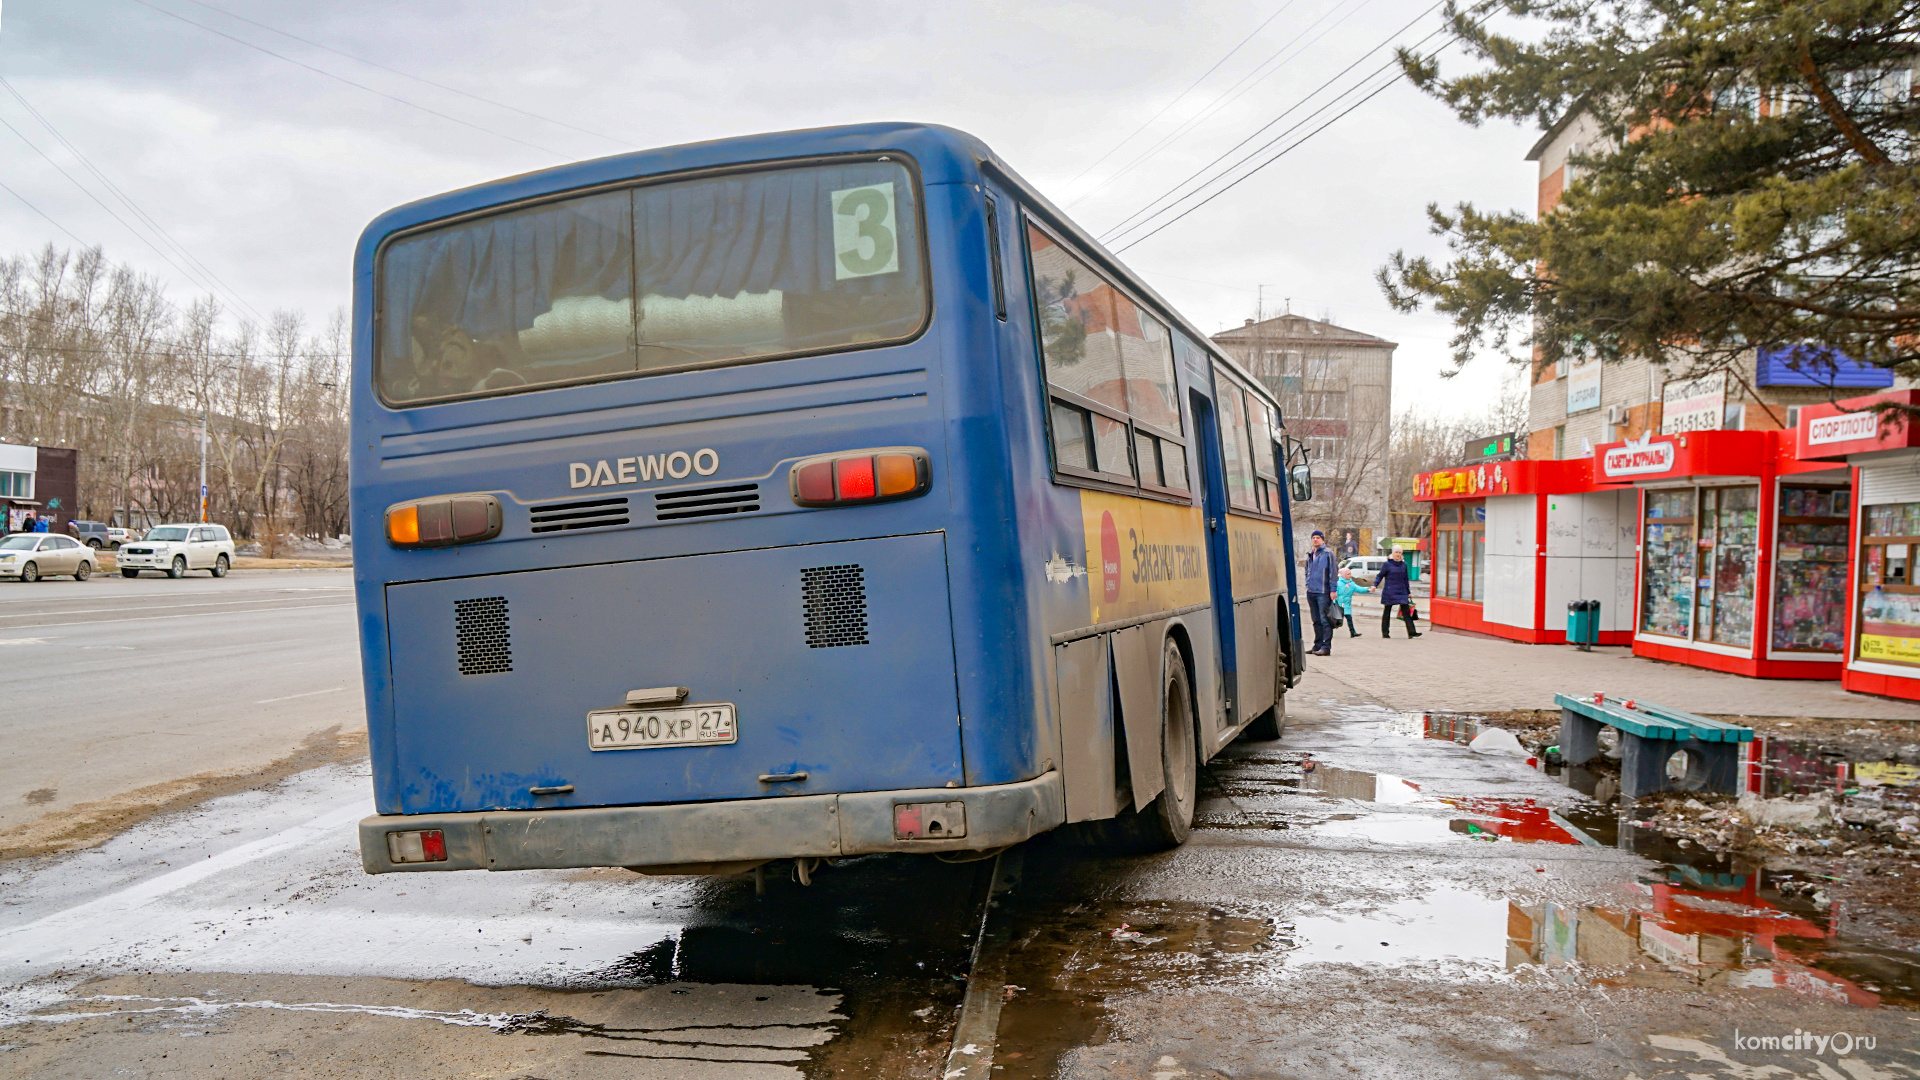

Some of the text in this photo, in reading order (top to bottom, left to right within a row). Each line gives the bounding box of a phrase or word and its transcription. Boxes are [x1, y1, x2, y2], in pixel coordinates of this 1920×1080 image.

[837, 188, 894, 274] 3
[1674, 410, 1716, 433] 51-51-33
[1812, 416, 1874, 439] СПОРТЛОТО
[569, 448, 719, 489] DAEWOO
[1129, 527, 1175, 583] Закажи
[1175, 545, 1201, 579] такси
[700, 711, 722, 730] 27
[700, 730, 718, 738] RUS
